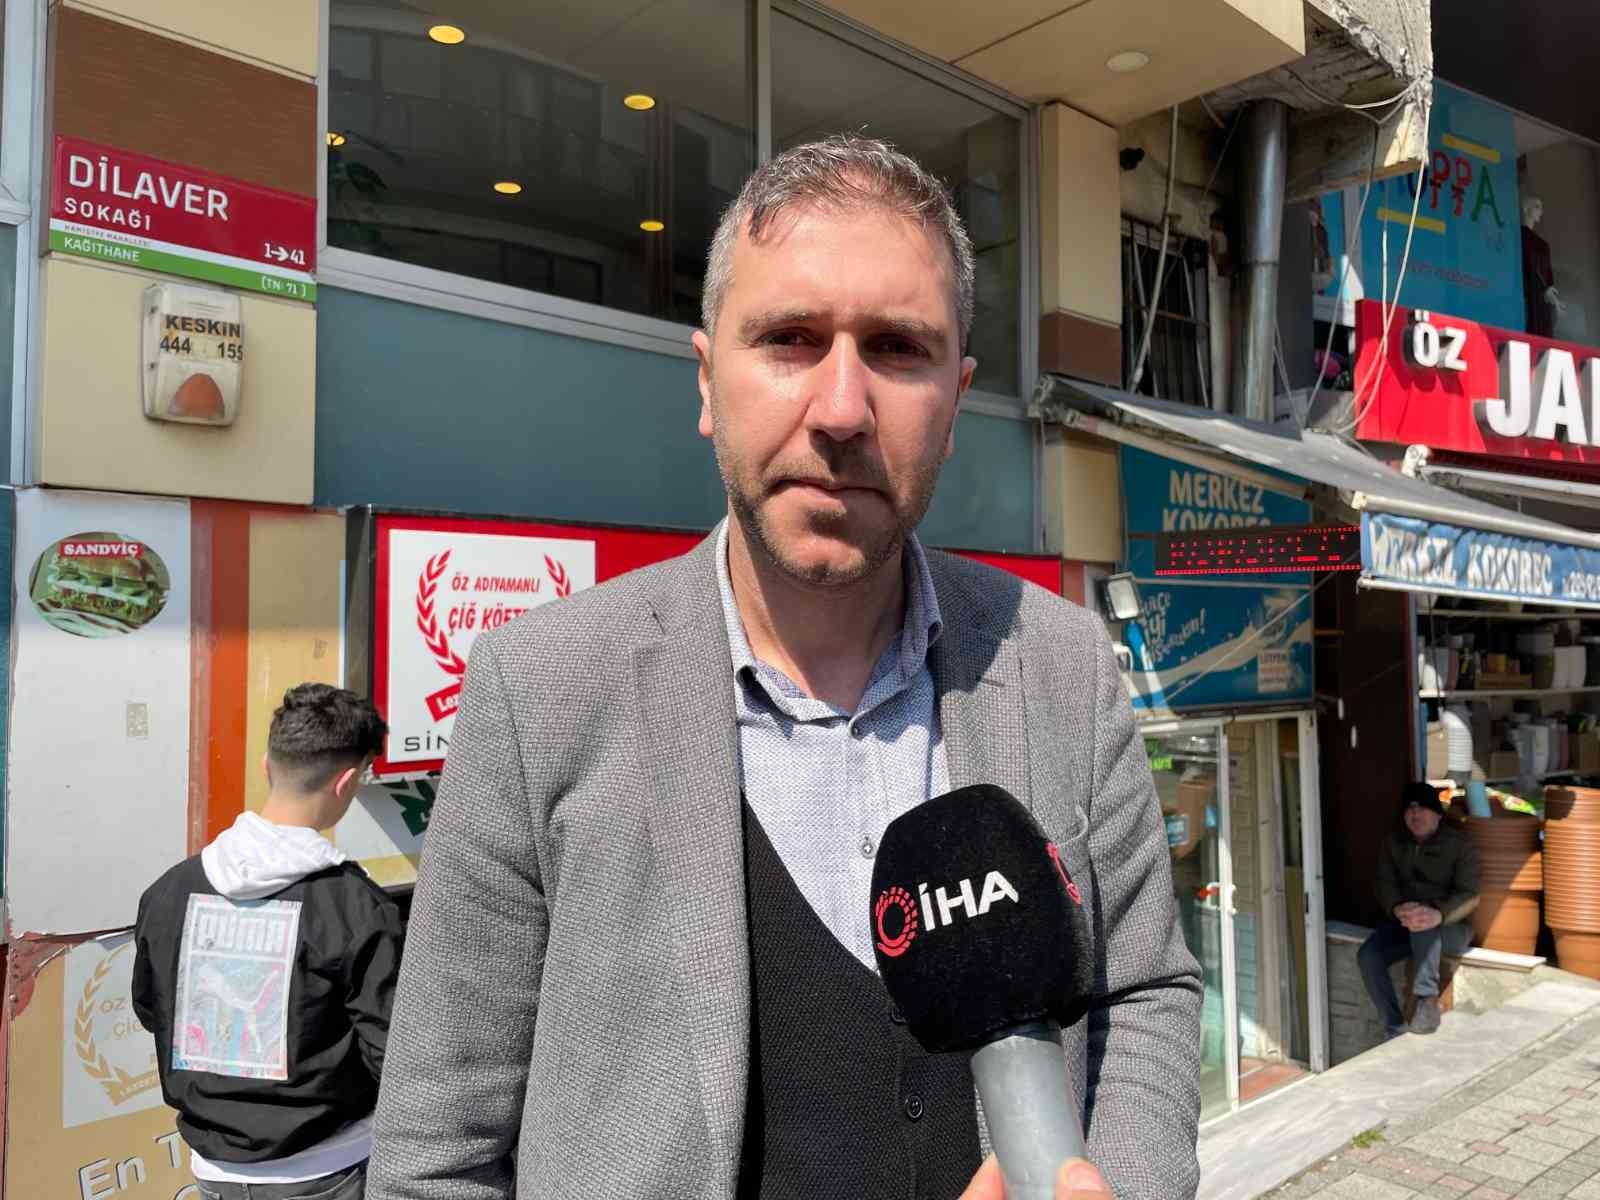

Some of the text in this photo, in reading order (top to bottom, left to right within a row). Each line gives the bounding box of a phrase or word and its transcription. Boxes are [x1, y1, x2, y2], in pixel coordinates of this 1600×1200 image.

[68, 154, 230, 221] DİLAVER
[64, 197, 151, 231] SOKAĞI
[64, 236, 141, 262] KAĞITHANE
[160, 335, 192, 354] 444
[1404, 308, 1468, 372] ÖZ
[1168, 468, 1266, 514] MERKEZ
[63, 541, 139, 558] SANDVİÇ
[451, 571, 541, 593] ÖZ ADIYAMANLI
[448, 601, 477, 636] ÇİĞ
[917, 869, 1020, 932] İHA
[78, 1155, 146, 1200] En
